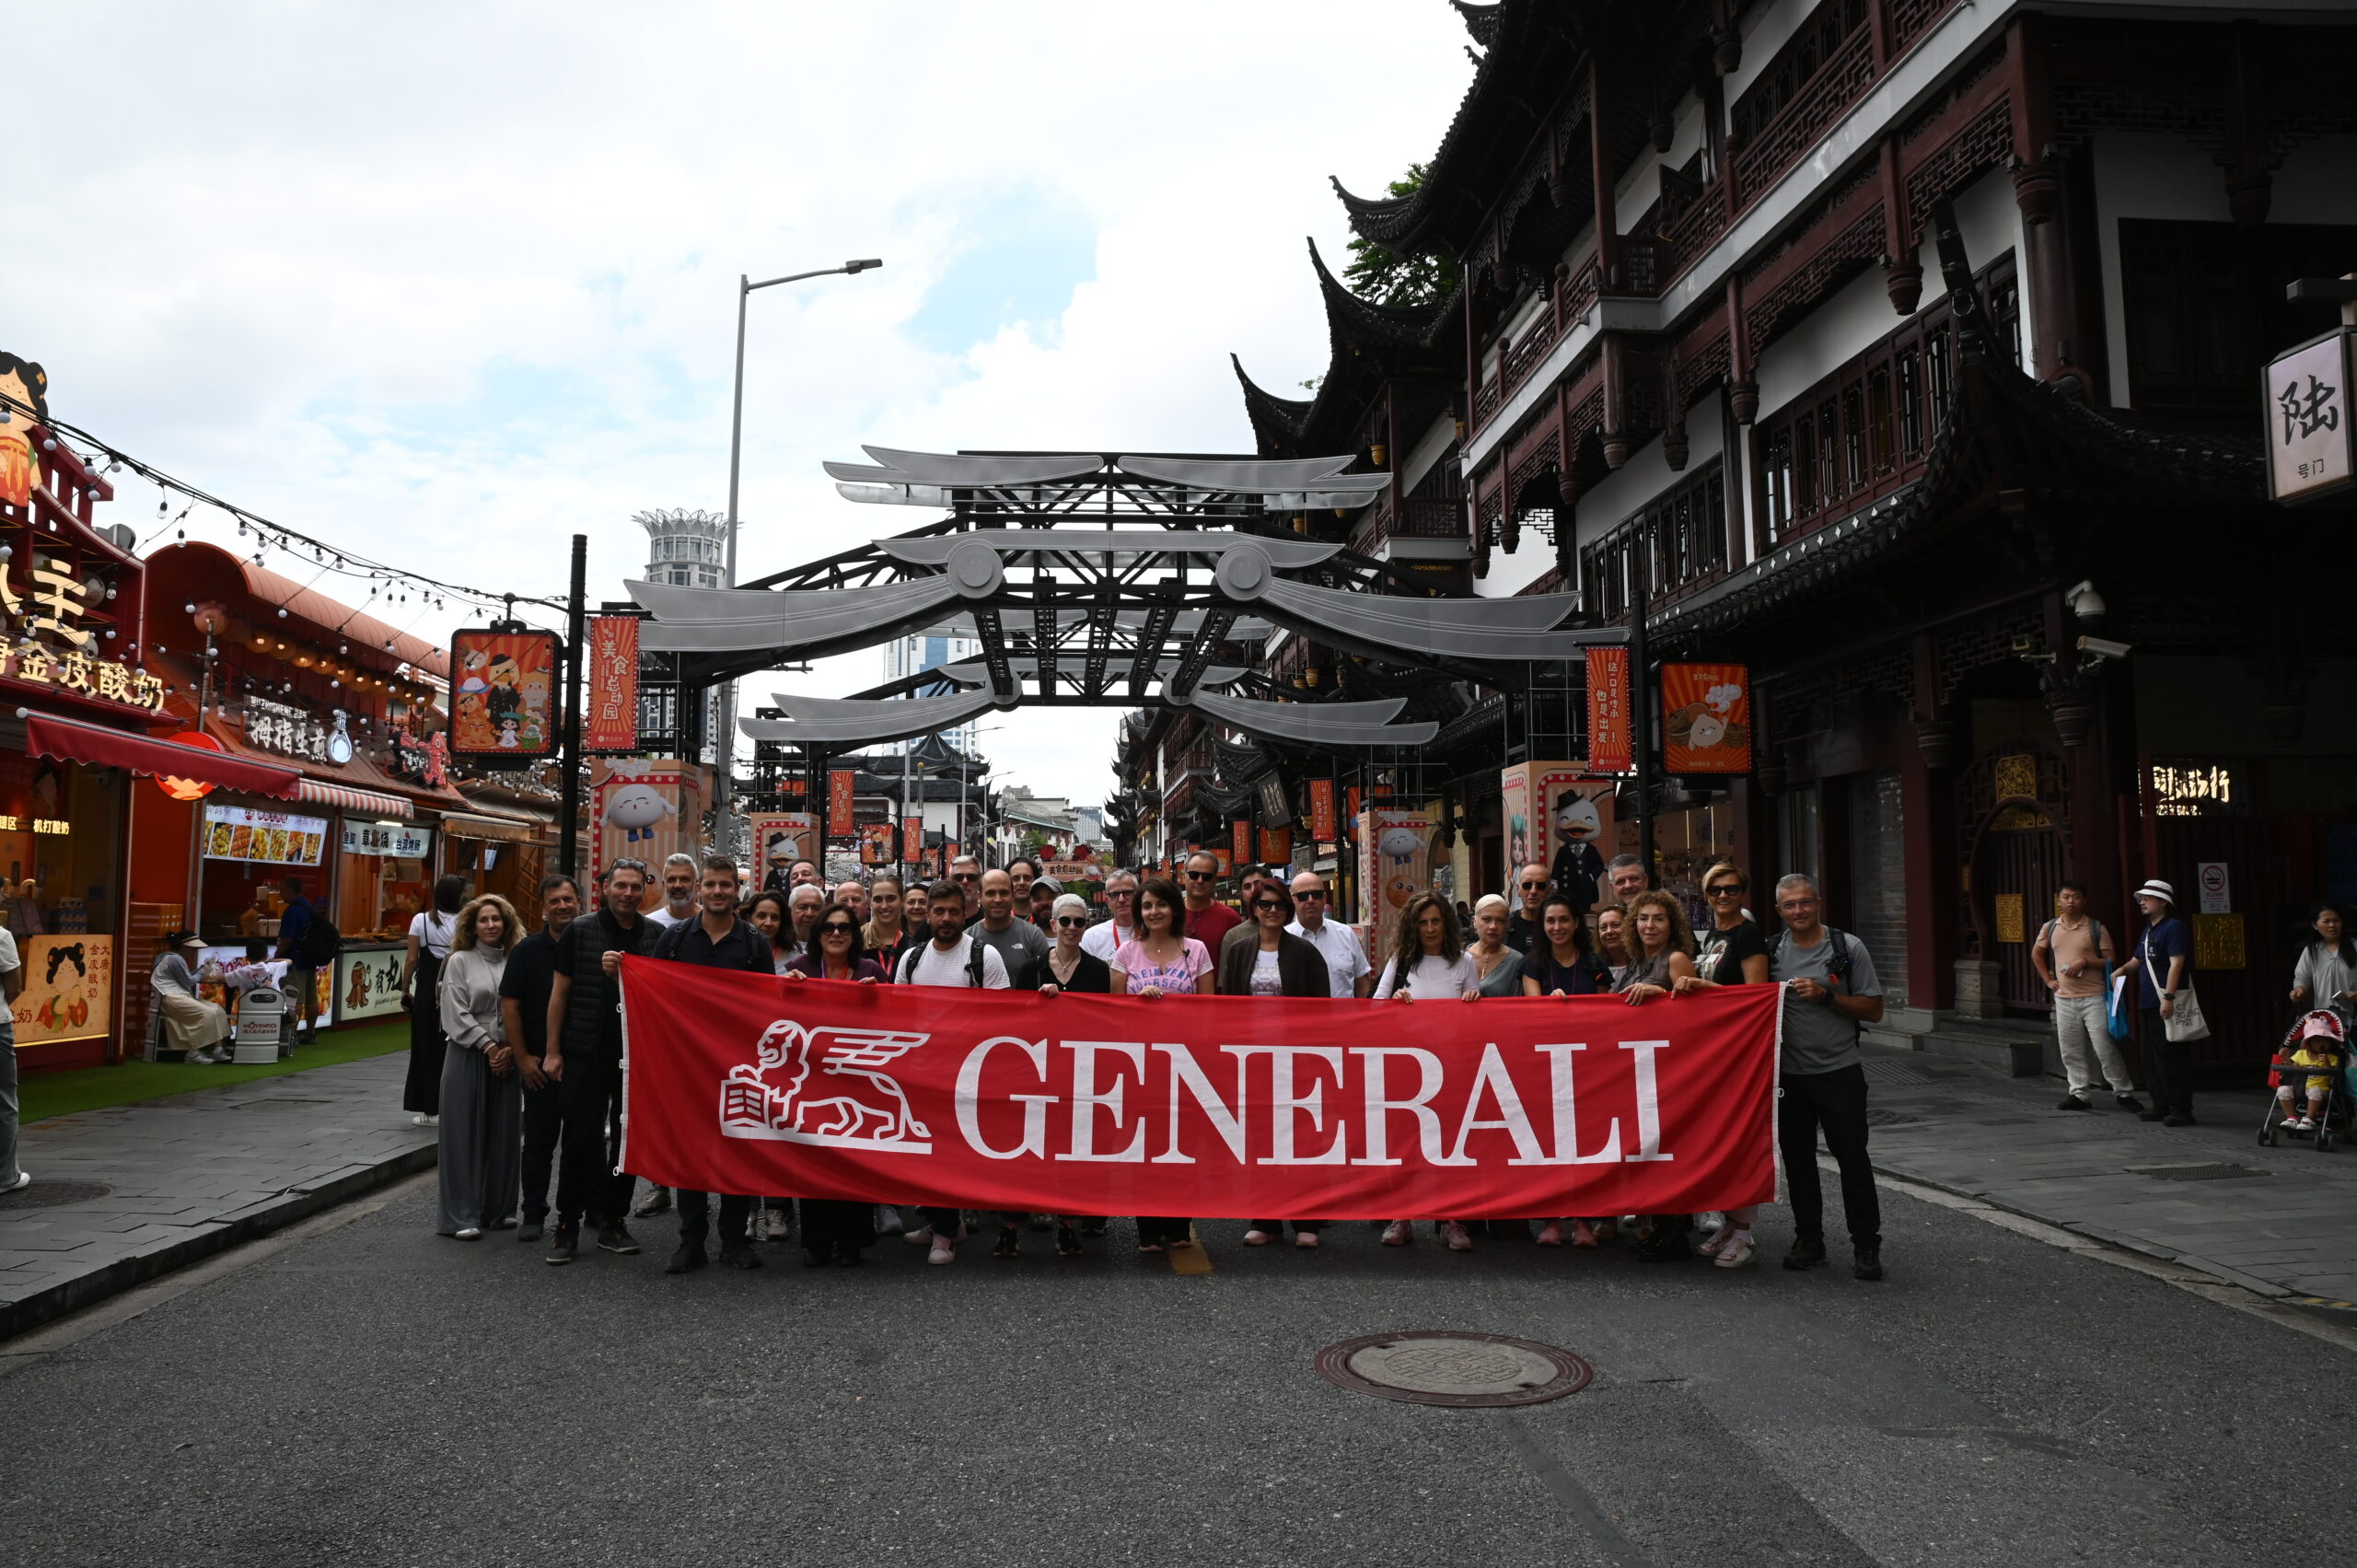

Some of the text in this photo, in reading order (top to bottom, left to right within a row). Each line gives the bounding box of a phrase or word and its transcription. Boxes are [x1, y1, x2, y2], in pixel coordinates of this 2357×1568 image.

[2297, 458, 2325, 479] 号门
[250, 715, 327, 762] 拇指生煎
[87, 945, 100, 999] 金皮酸奶
[954, 1036, 1674, 1167] GENERALI
